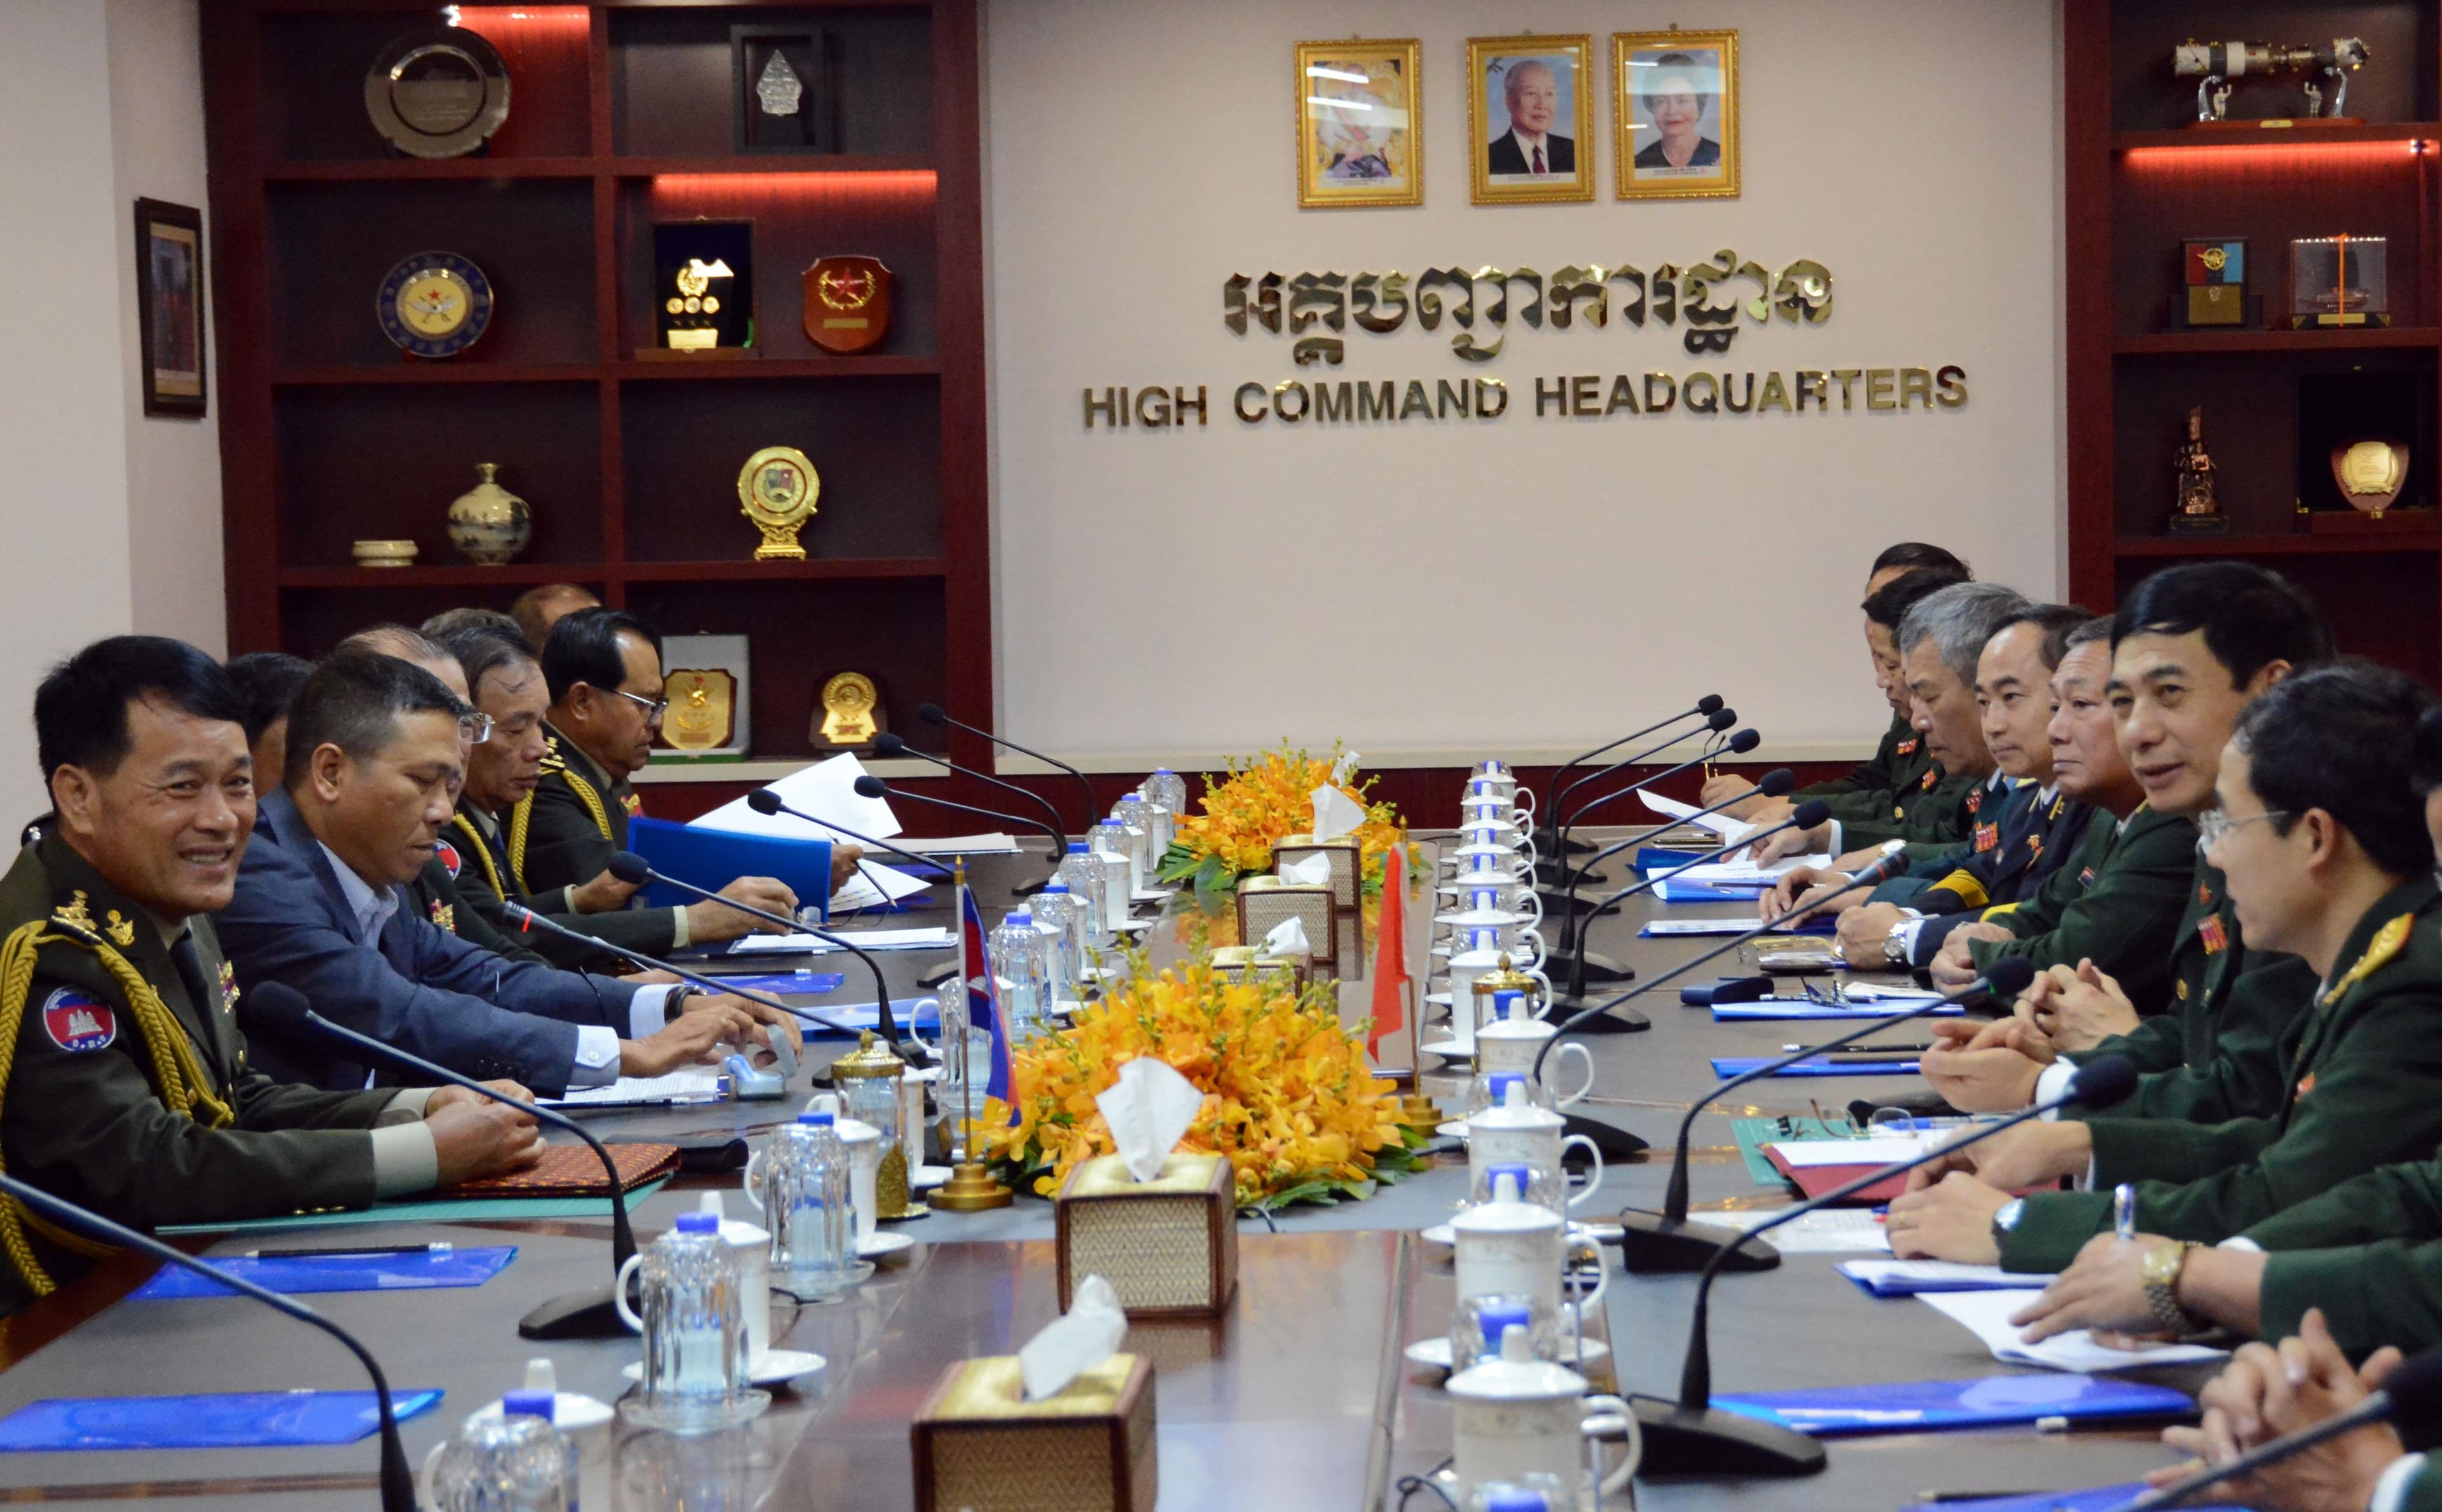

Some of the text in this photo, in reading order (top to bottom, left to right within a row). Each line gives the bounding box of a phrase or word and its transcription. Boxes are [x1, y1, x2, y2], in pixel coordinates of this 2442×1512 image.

[1084, 366, 1968, 428] HIGH COMMAND HEADQUARTERS
